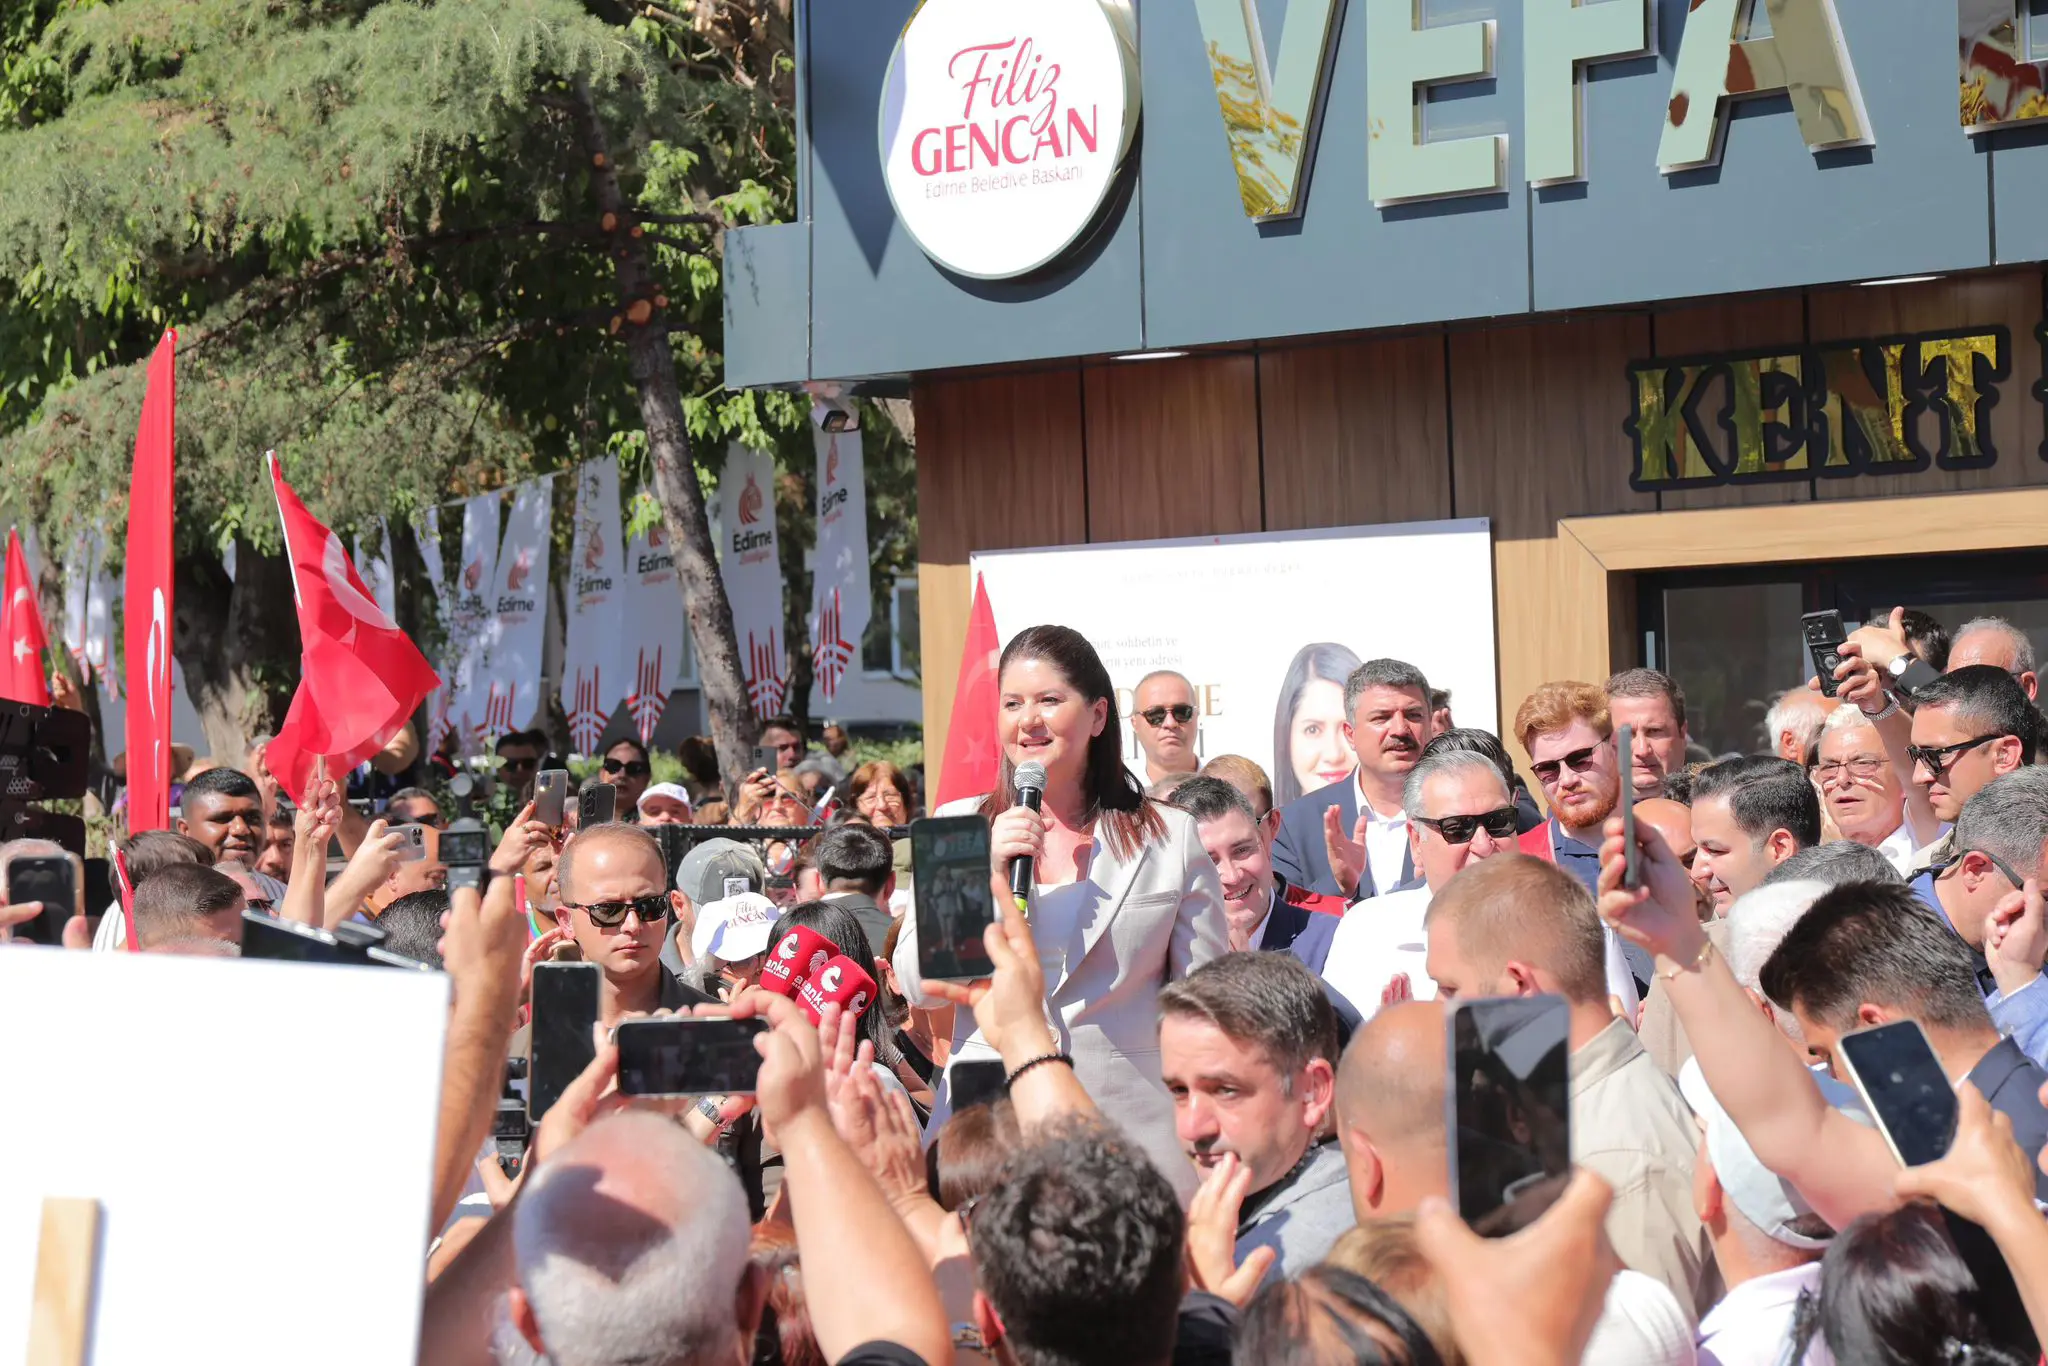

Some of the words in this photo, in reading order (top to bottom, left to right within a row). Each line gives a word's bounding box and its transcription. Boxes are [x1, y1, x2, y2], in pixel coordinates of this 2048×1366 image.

[948, 36, 1061, 136] Filiz
[911, 104, 1097, 176] GENCAN
[925, 180, 967, 199] Edirne
[1632, 331, 2001, 486] KENT
[733, 530, 772, 552] Edirne
[497, 596, 534, 613] Edirne
[765, 959, 791, 977] anka
